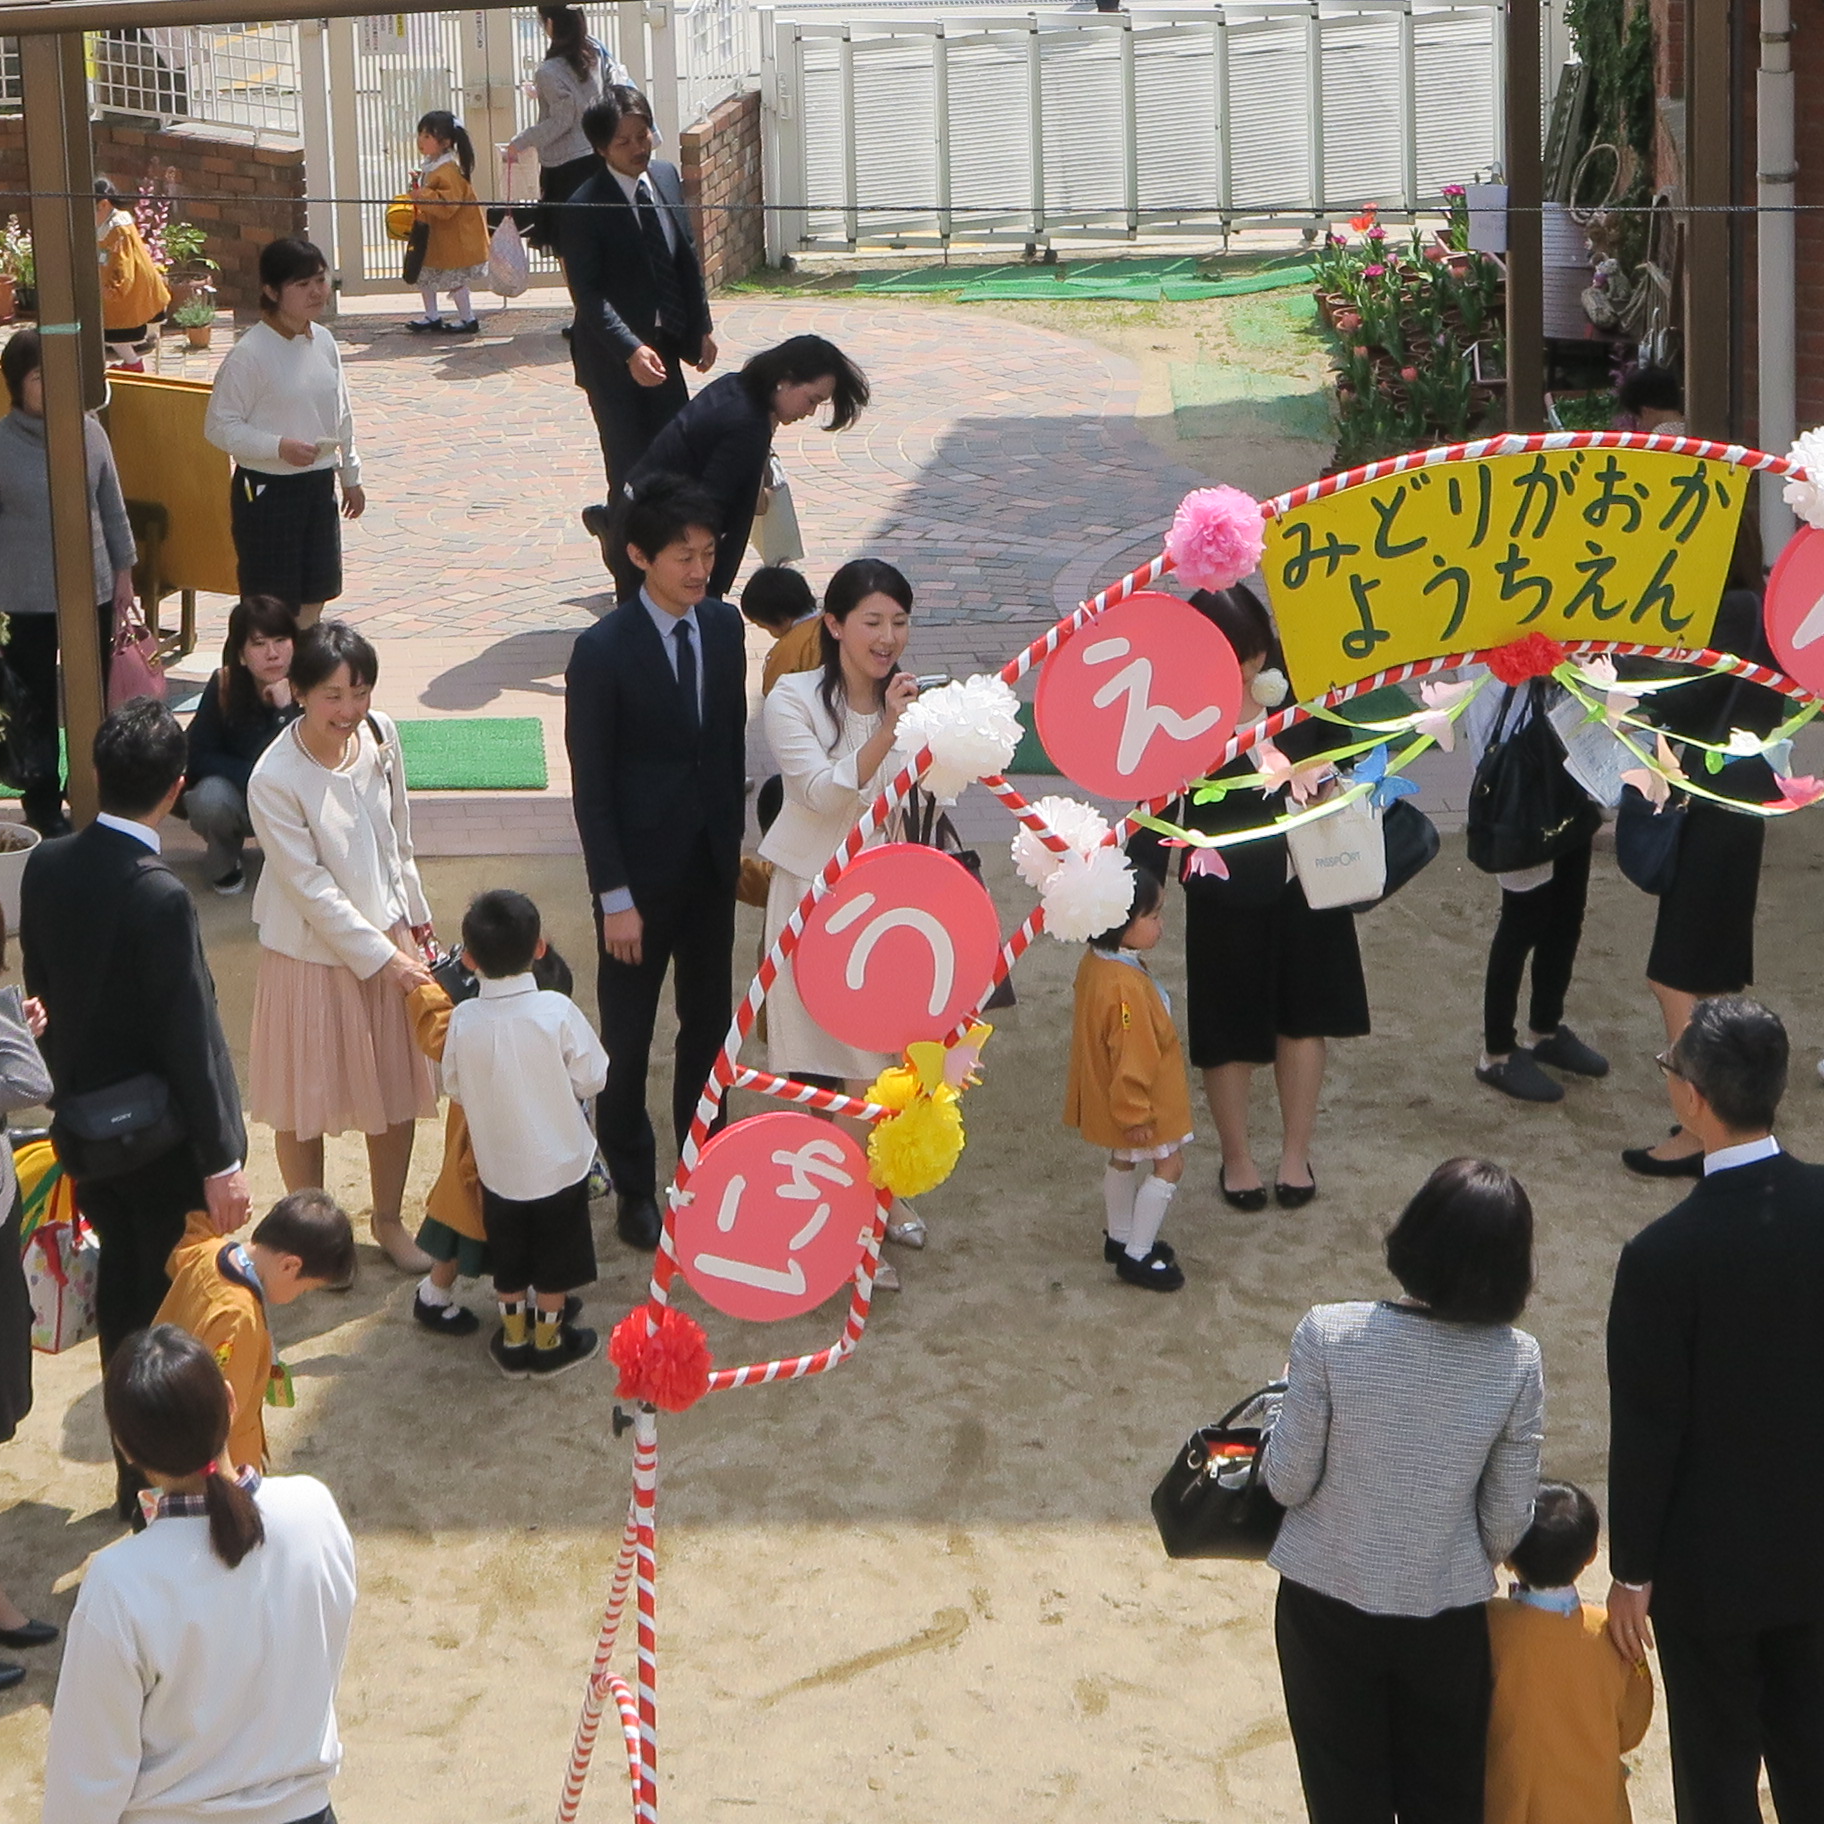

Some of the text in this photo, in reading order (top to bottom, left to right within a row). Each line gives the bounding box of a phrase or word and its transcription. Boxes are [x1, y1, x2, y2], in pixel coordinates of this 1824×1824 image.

[1282, 451, 1731, 590] みどりがおか
[1342, 540, 1695, 659] ようちえん
[1082, 637, 1222, 776] え
[1314, 851, 1362, 868] PASSPORT
